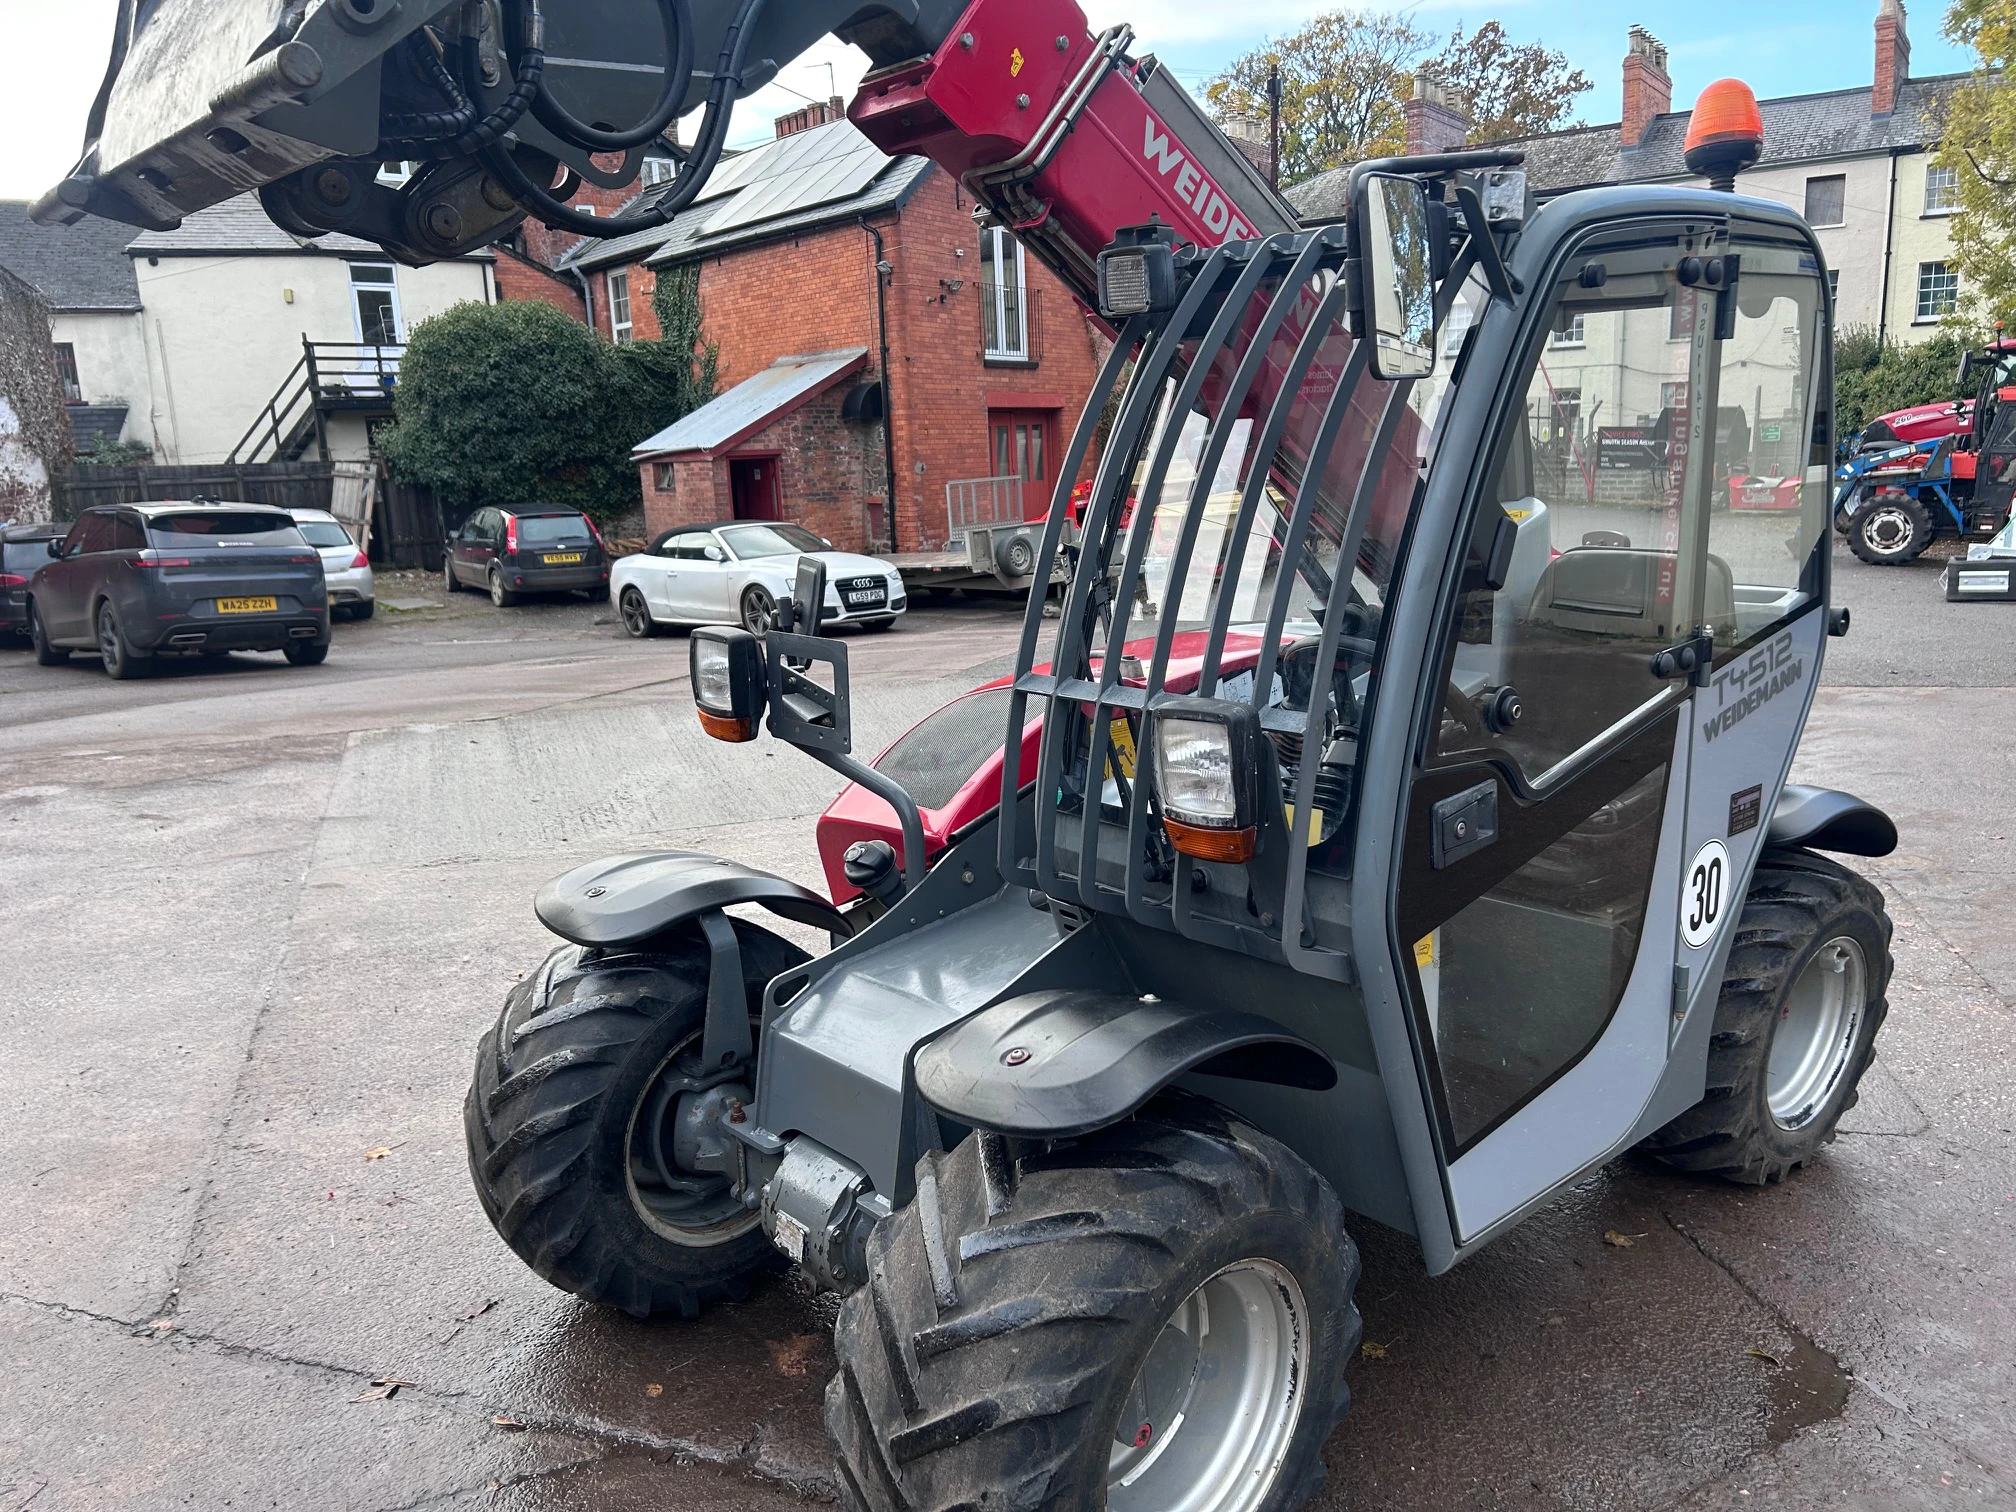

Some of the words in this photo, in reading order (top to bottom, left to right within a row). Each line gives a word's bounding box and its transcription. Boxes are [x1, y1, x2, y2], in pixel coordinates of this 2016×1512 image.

[222, 600, 249, 610] WA25
[252, 599, 271, 609] ZZH
[1702, 658, 1802, 744] WEIDEMANN
[1712, 631, 1793, 707] T4512
[1690, 857, 1722, 932] 30
